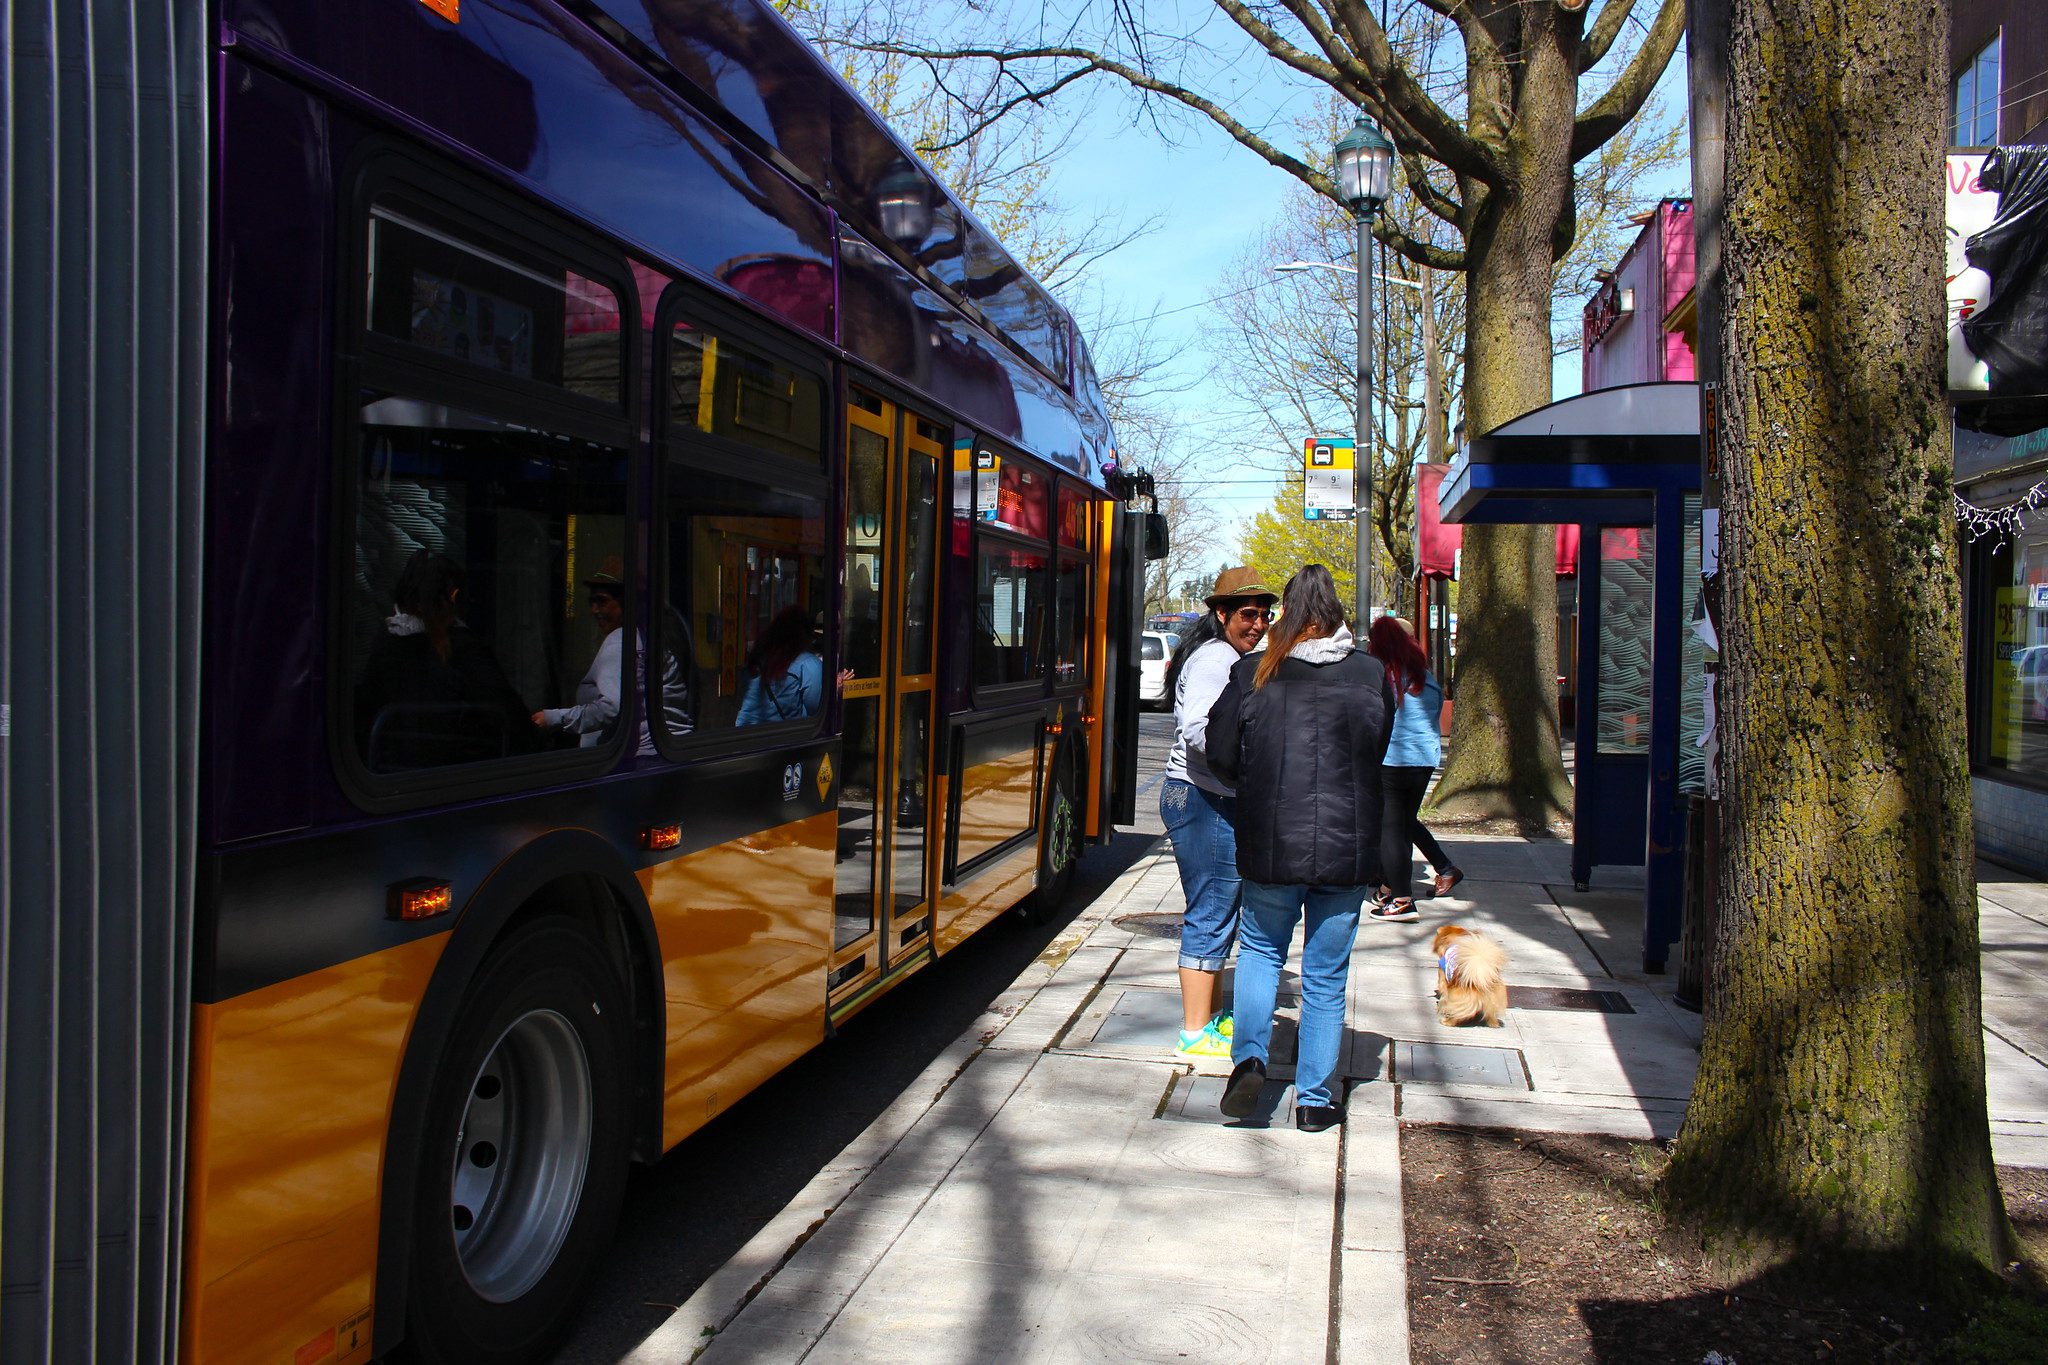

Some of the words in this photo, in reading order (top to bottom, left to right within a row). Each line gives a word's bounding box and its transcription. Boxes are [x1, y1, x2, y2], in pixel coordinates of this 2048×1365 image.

[1707, 390, 1717, 473] 5612
[1308, 475, 1313, 484] 7
[1331, 475, 1337, 484] 9
